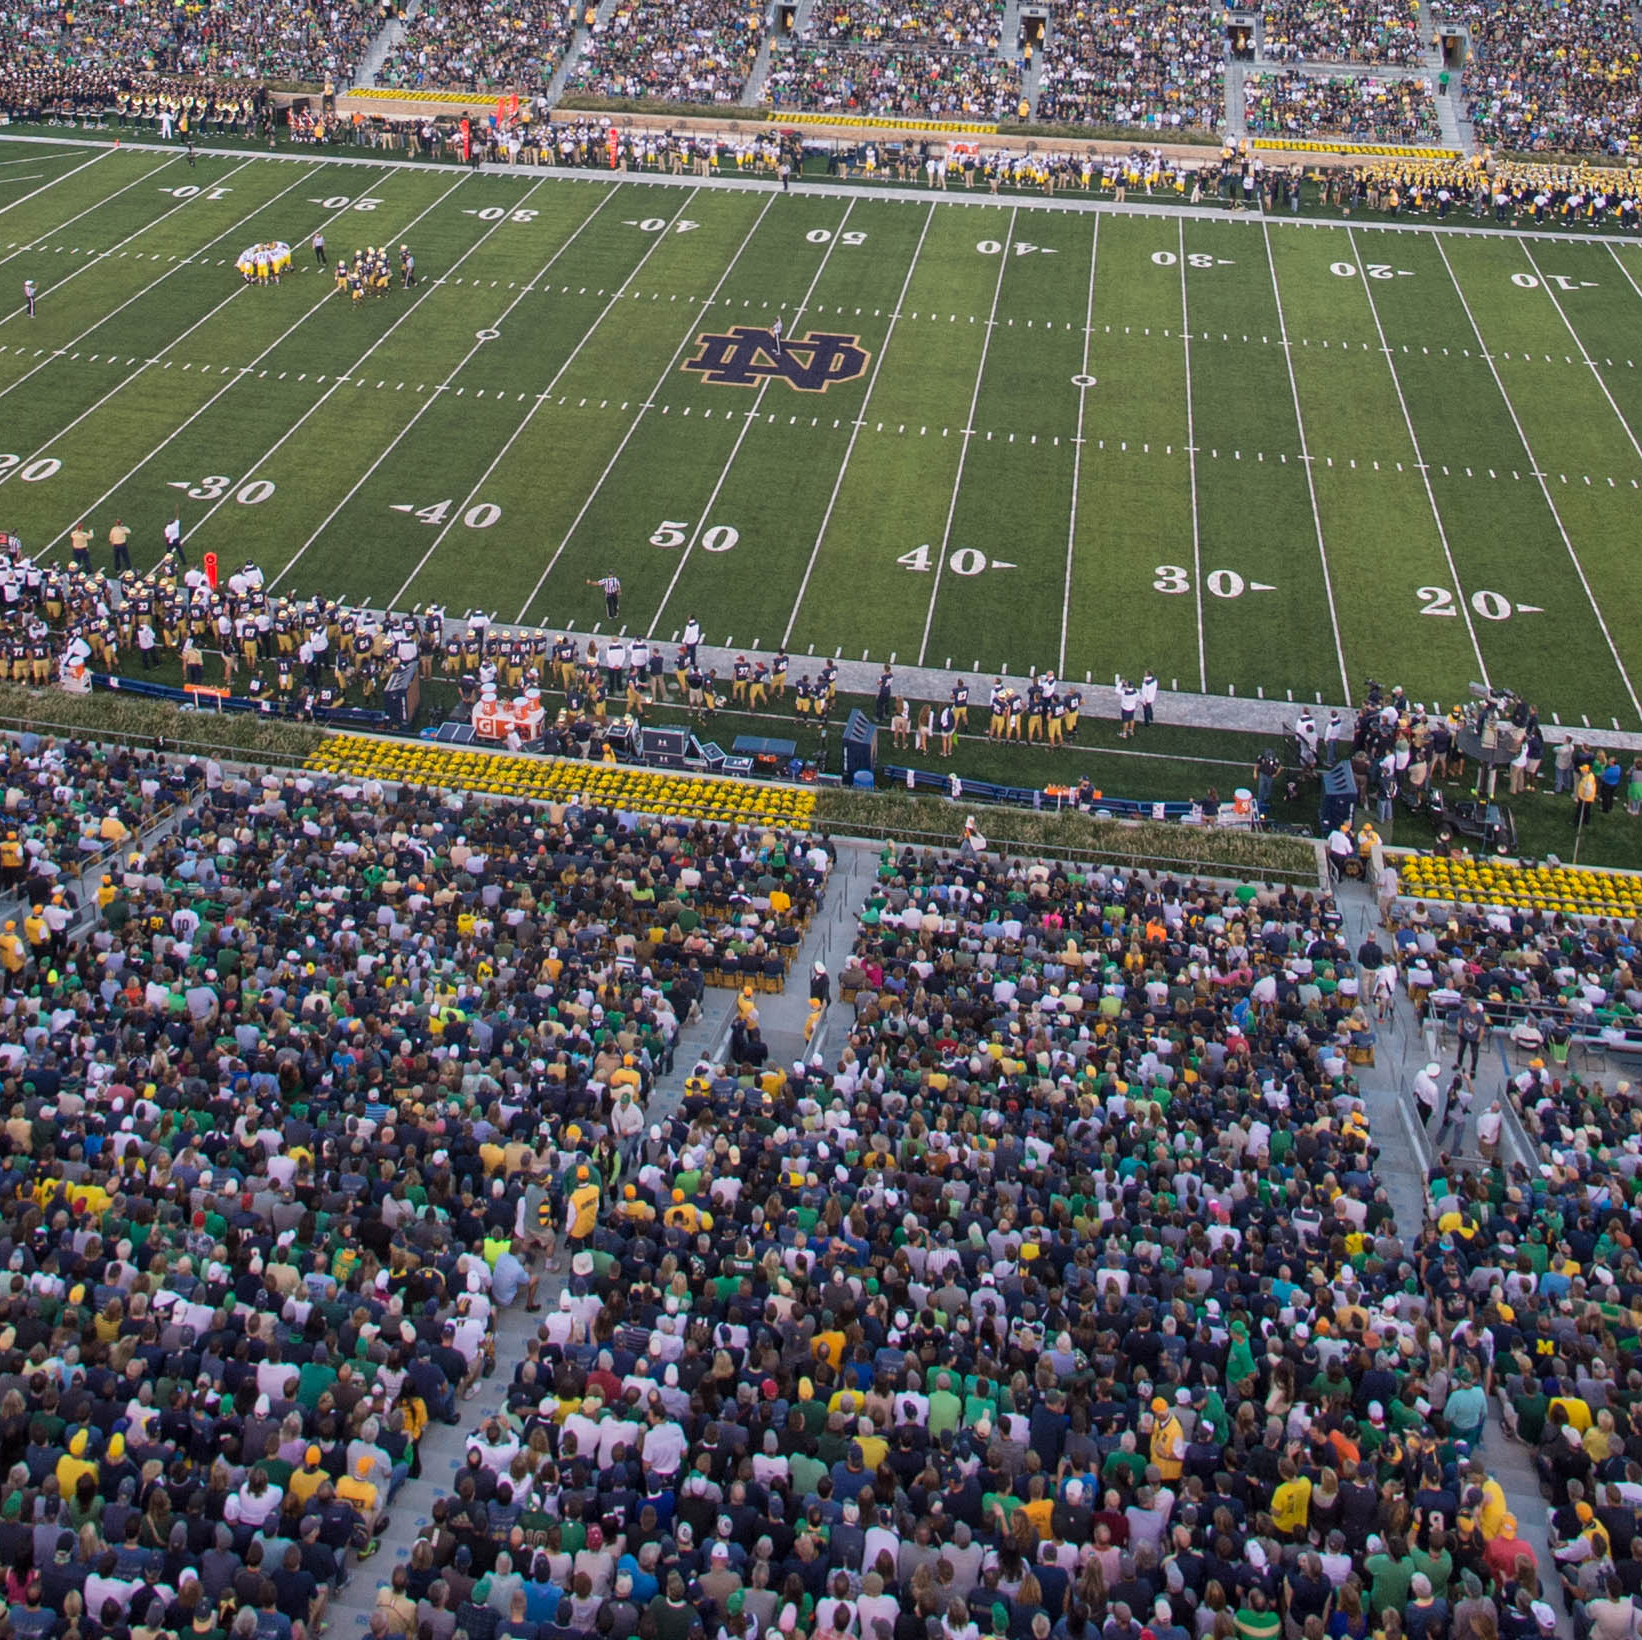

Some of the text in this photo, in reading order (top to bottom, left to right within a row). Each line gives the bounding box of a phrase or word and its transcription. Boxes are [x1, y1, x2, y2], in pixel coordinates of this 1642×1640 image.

[680, 324, 872, 393] ND
[187, 475, 276, 505] 30
[415, 499, 502, 528] 40
[649, 520, 739, 551] 50
[896, 544, 987, 575] 40
[1153, 565, 1244, 598] 30
[1416, 587, 1512, 620] 20
[478, 720, 492, 733] G
[176, 917, 191, 932] 10
[1536, 1339, 1555, 1356] M
